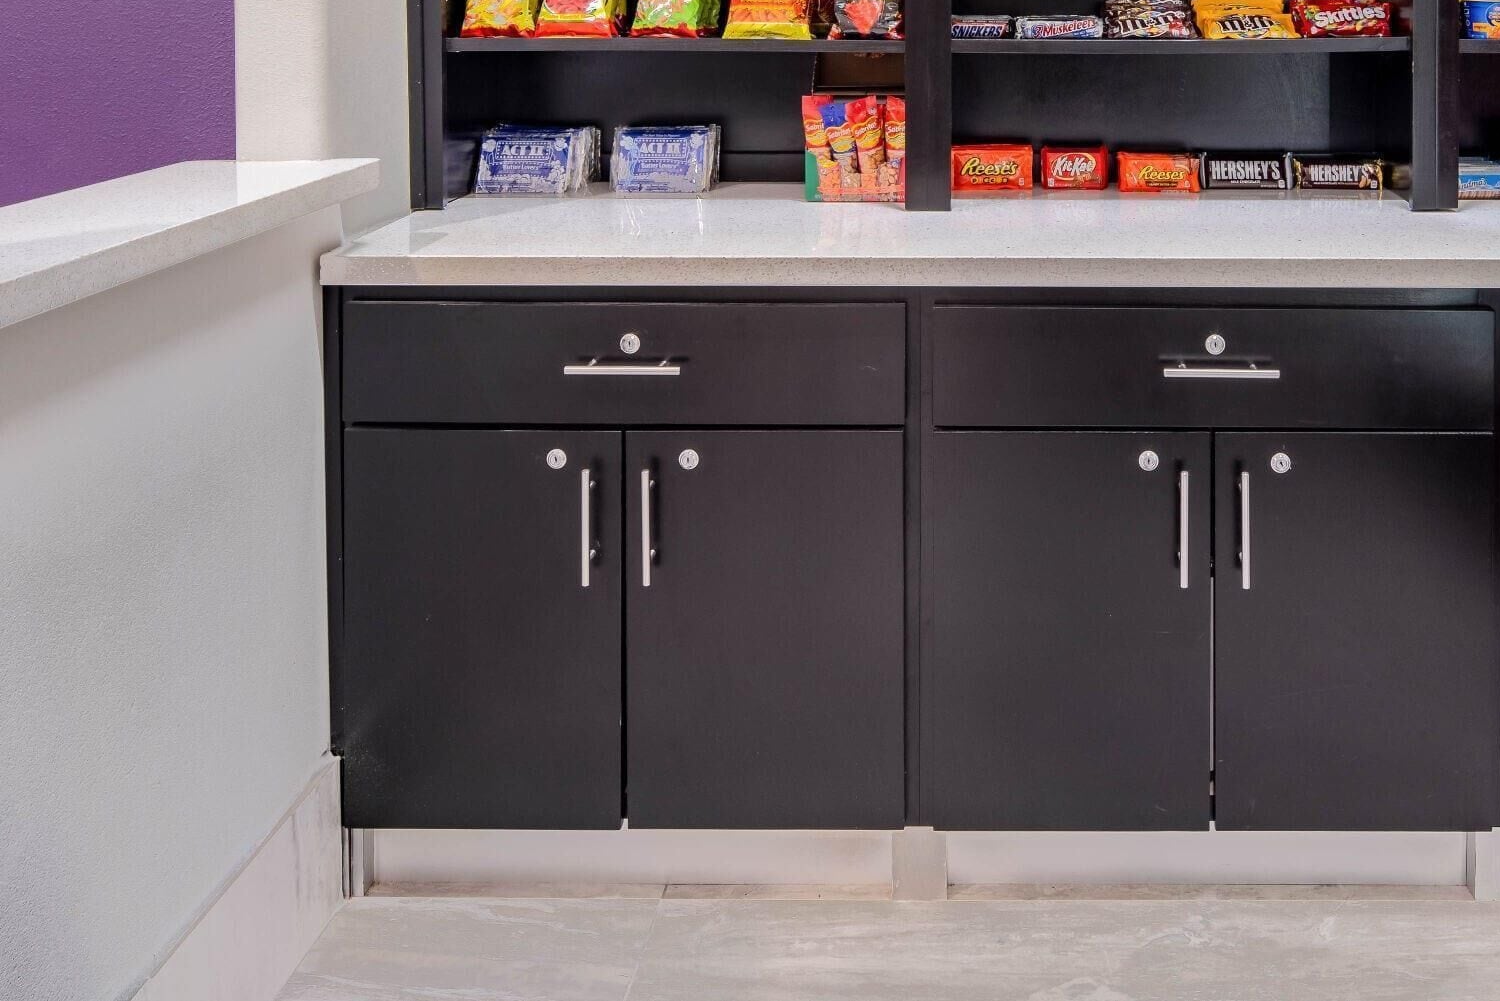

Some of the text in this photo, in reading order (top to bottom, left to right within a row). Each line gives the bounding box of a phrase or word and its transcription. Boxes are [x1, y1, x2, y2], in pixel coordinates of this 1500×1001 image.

[1314, 6, 1386, 27] Skittles
[951, 24, 1004, 37] SNICKERS
[1042, 19, 1097, 37] Musketeers
[501, 144, 545, 156] ACT II
[640, 142, 681, 154] ACT II
[961, 156, 1019, 176] Reese's
[1211, 160, 1280, 180] HERSHEY'S
[1310, 164, 1369, 182] HERSHEY'S
